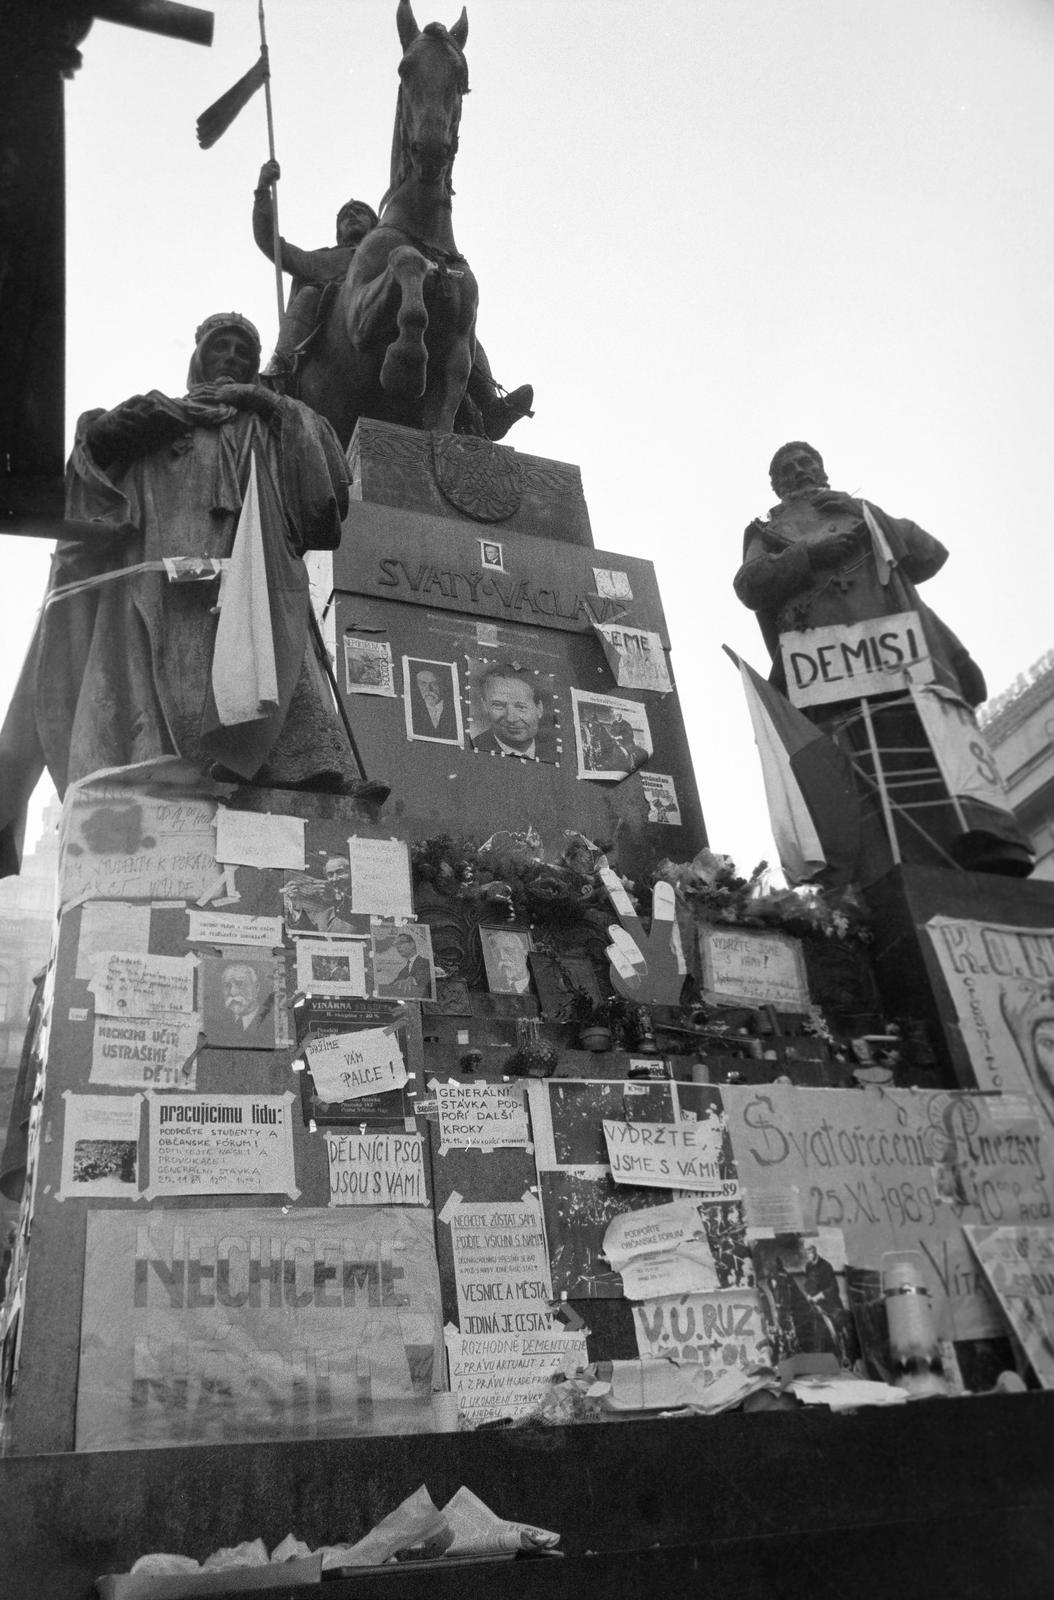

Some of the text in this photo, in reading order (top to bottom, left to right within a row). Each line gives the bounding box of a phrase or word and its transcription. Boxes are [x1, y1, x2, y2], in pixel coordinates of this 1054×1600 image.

[602, 630, 651, 651] EME
[790, 629, 918, 689] DEMISI
[340, 1066, 383, 1087] PALCE
[439, 1086, 513, 1098] GENERÁLNÍ
[159, 1102, 243, 1125] pracujícímu
[252, 1104, 283, 1124] lidu:
[441, 1098, 488, 1109] STÁVKA
[442, 1109, 514, 1121] POŘÍ DALŠÍ
[211, 1128, 261, 1136] STUDENTY
[269, 1130, 278, 1138] A
[443, 1124, 484, 1134] KROKY
[613, 1153, 656, 1172] JSME
[659, 1159, 670, 1174] S
[332, 1170, 369, 1194] JSOU
[372, 1171, 381, 1193] S
[134, 1226, 410, 1308] NECHCEME
[462, 1283, 504, 1302] VESNICE
[506, 1287, 514, 1300] A
[464, 1313, 500, 1334] JEDINÁ
[501, 1314, 514, 1332] JE
